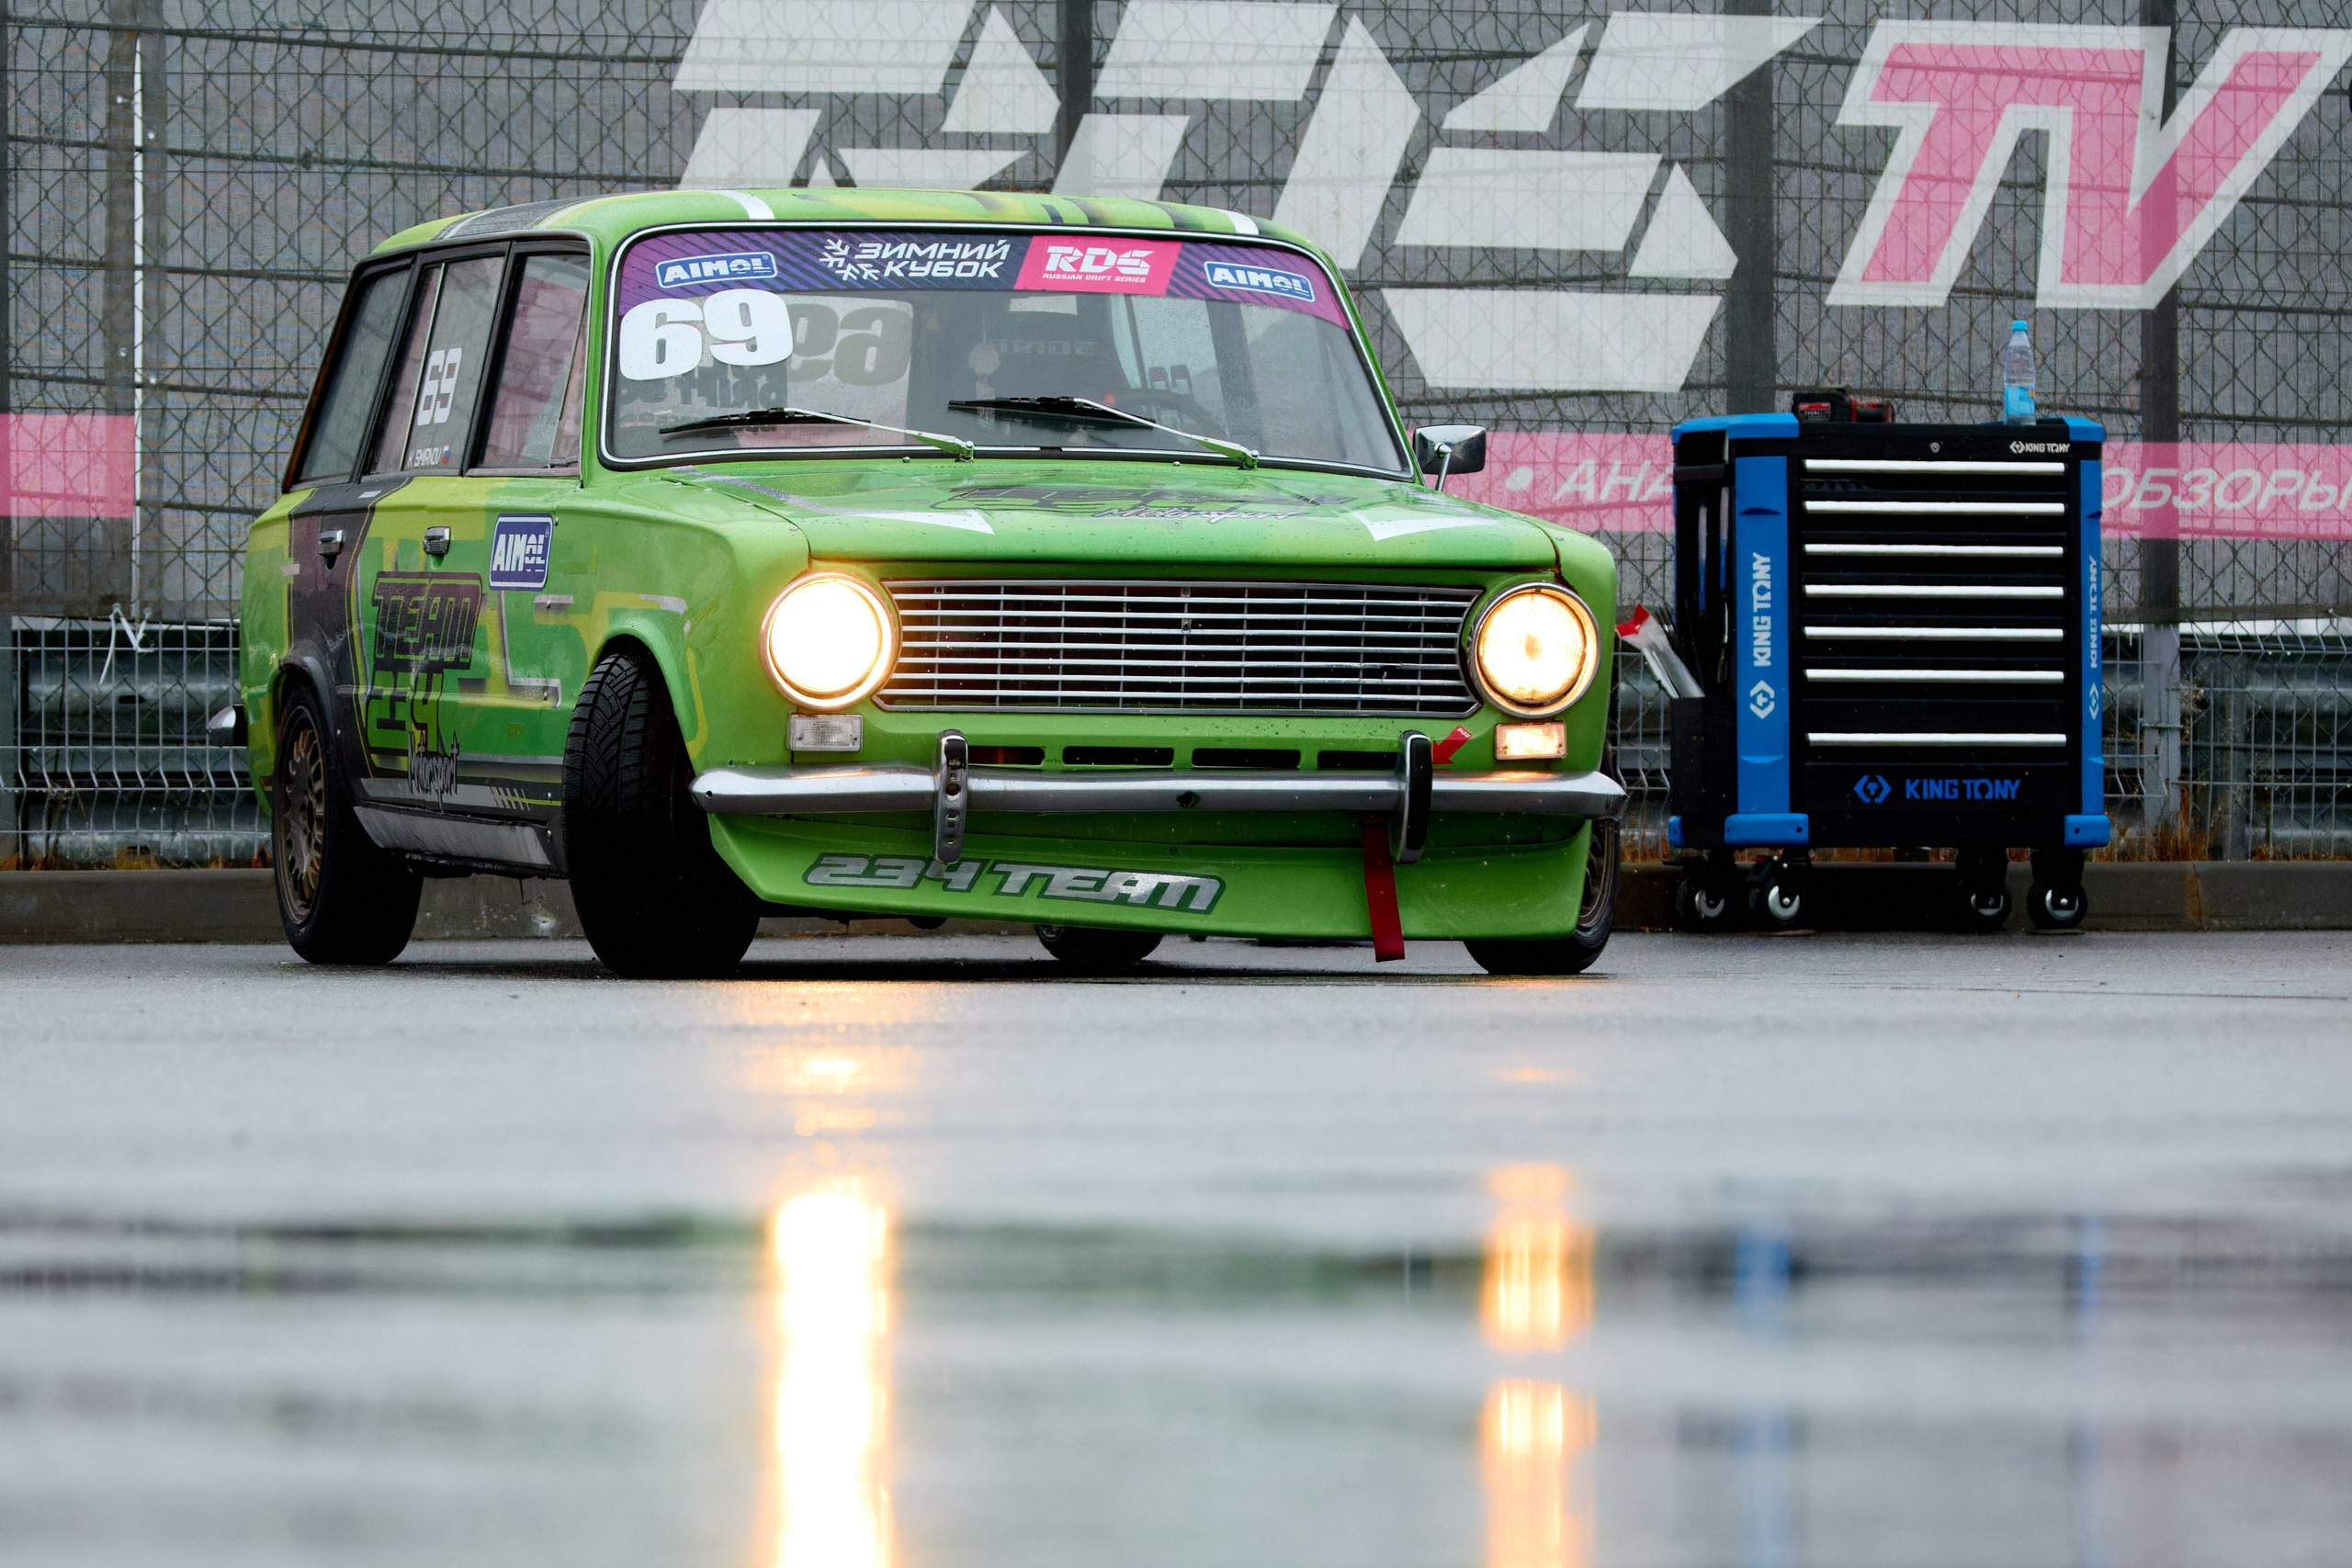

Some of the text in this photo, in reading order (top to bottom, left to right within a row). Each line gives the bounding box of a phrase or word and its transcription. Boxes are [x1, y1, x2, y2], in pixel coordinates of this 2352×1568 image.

[1826, 19, 2352, 310] TV
[663, 256, 773, 284] AIMOL
[854, 239, 1011, 261] ЗИМНИЙ
[882, 261, 1005, 278] КУБОК
[1045, 245, 1154, 276] RDS
[1210, 267, 1311, 296] AIMOL
[619, 288, 794, 381] 69
[417, 347, 462, 426] 69
[2024, 443, 2071, 454] KING TONY
[2101, 466, 2352, 511] ОБЗОРЫ
[492, 534, 546, 572] AIMOL
[373, 575, 482, 665] TEAM
[1751, 551, 1771, 667] KING TONY
[2088, 554, 2098, 669] KING TONY
[1905, 777, 2021, 800] KING TONY
[803, 852, 1227, 914] 234 TEAM
